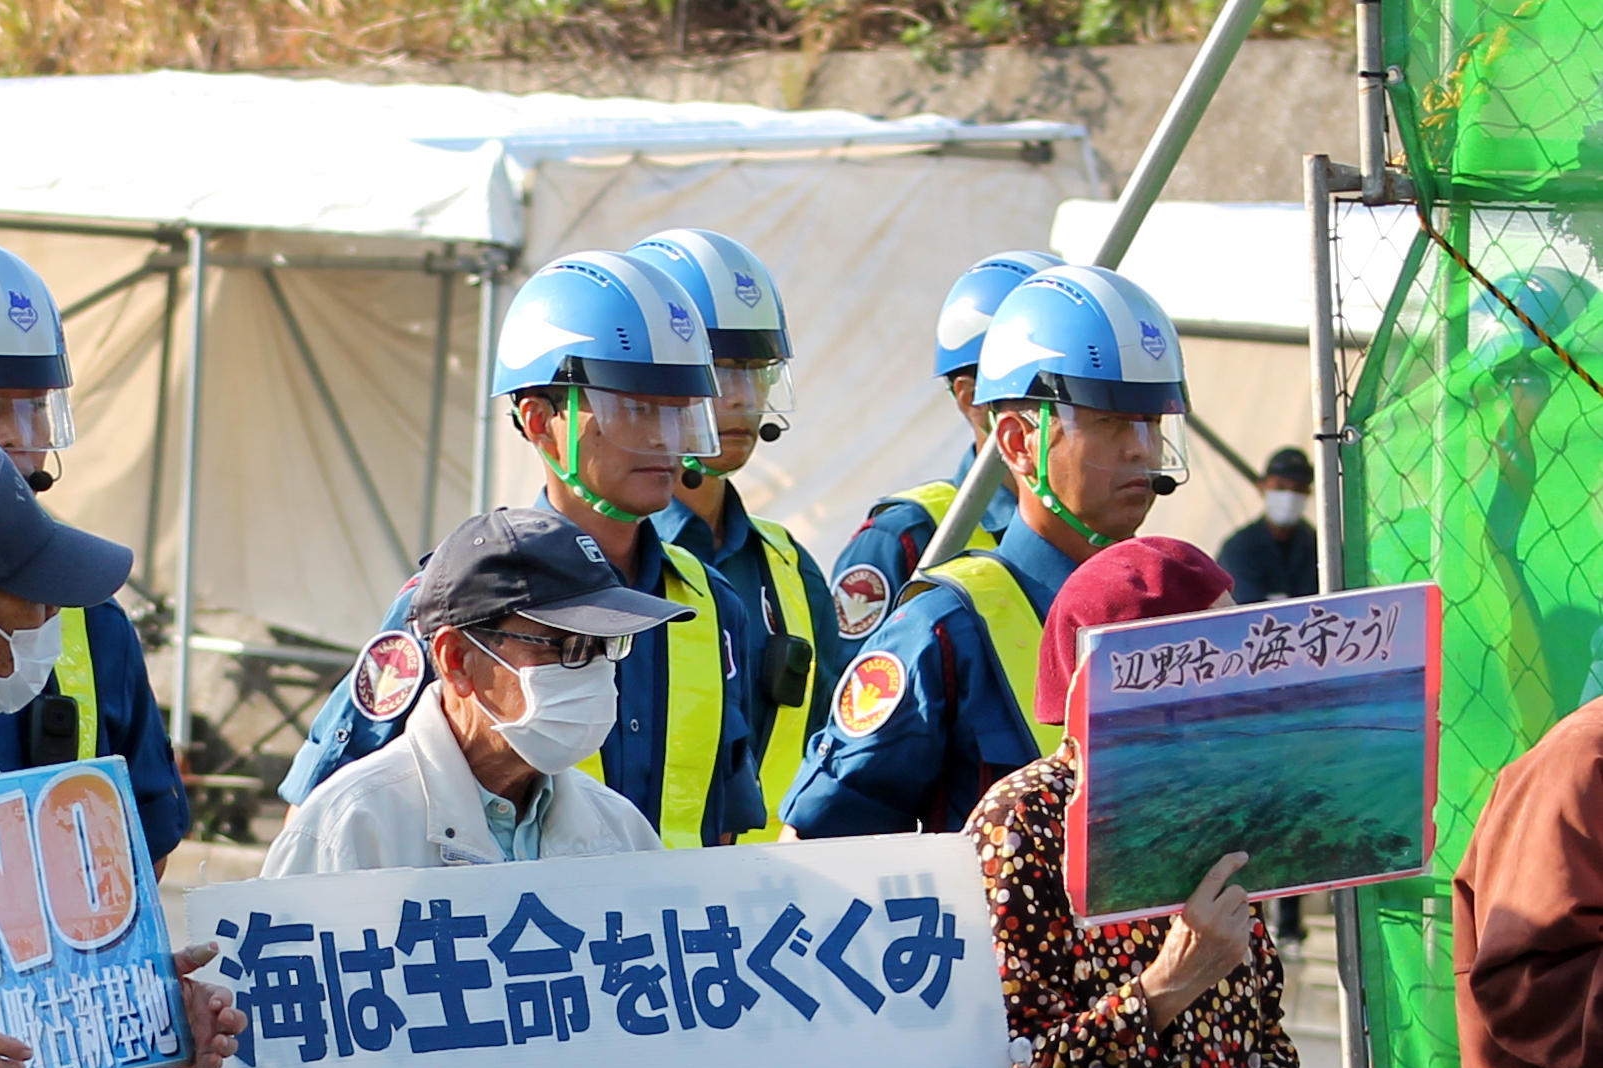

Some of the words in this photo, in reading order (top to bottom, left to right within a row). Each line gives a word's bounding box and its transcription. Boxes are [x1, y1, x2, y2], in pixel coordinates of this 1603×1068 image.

[860, 657, 900, 692] TASKFORCE
[215, 892, 965, 1067] 海は生命をはぐくみ
